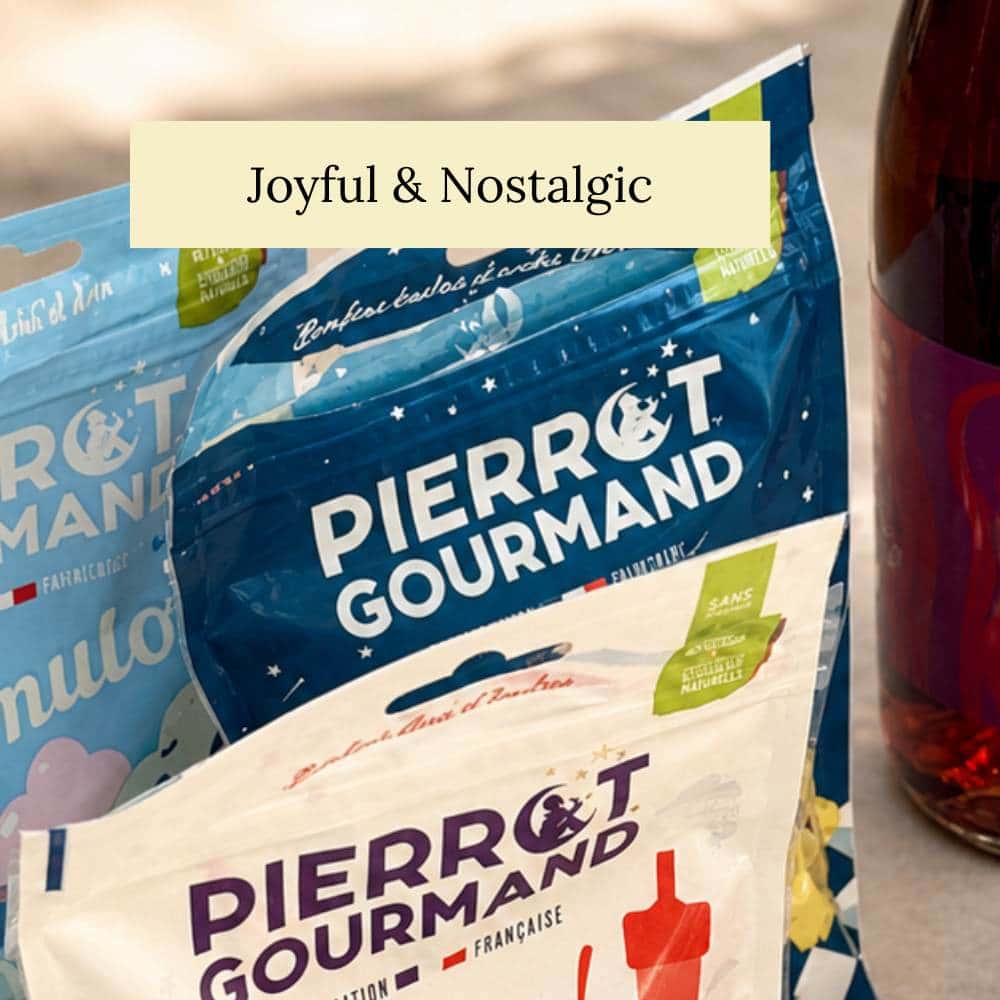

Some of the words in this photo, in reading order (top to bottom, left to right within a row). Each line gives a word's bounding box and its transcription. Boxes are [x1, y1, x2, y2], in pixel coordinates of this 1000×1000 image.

[312, 355, 723, 578] PIERROT
[336, 440, 744, 638] GOURMAND
[188, 753, 651, 957] PIERROT
[473, 905, 564, 959] FRANÇAISE
